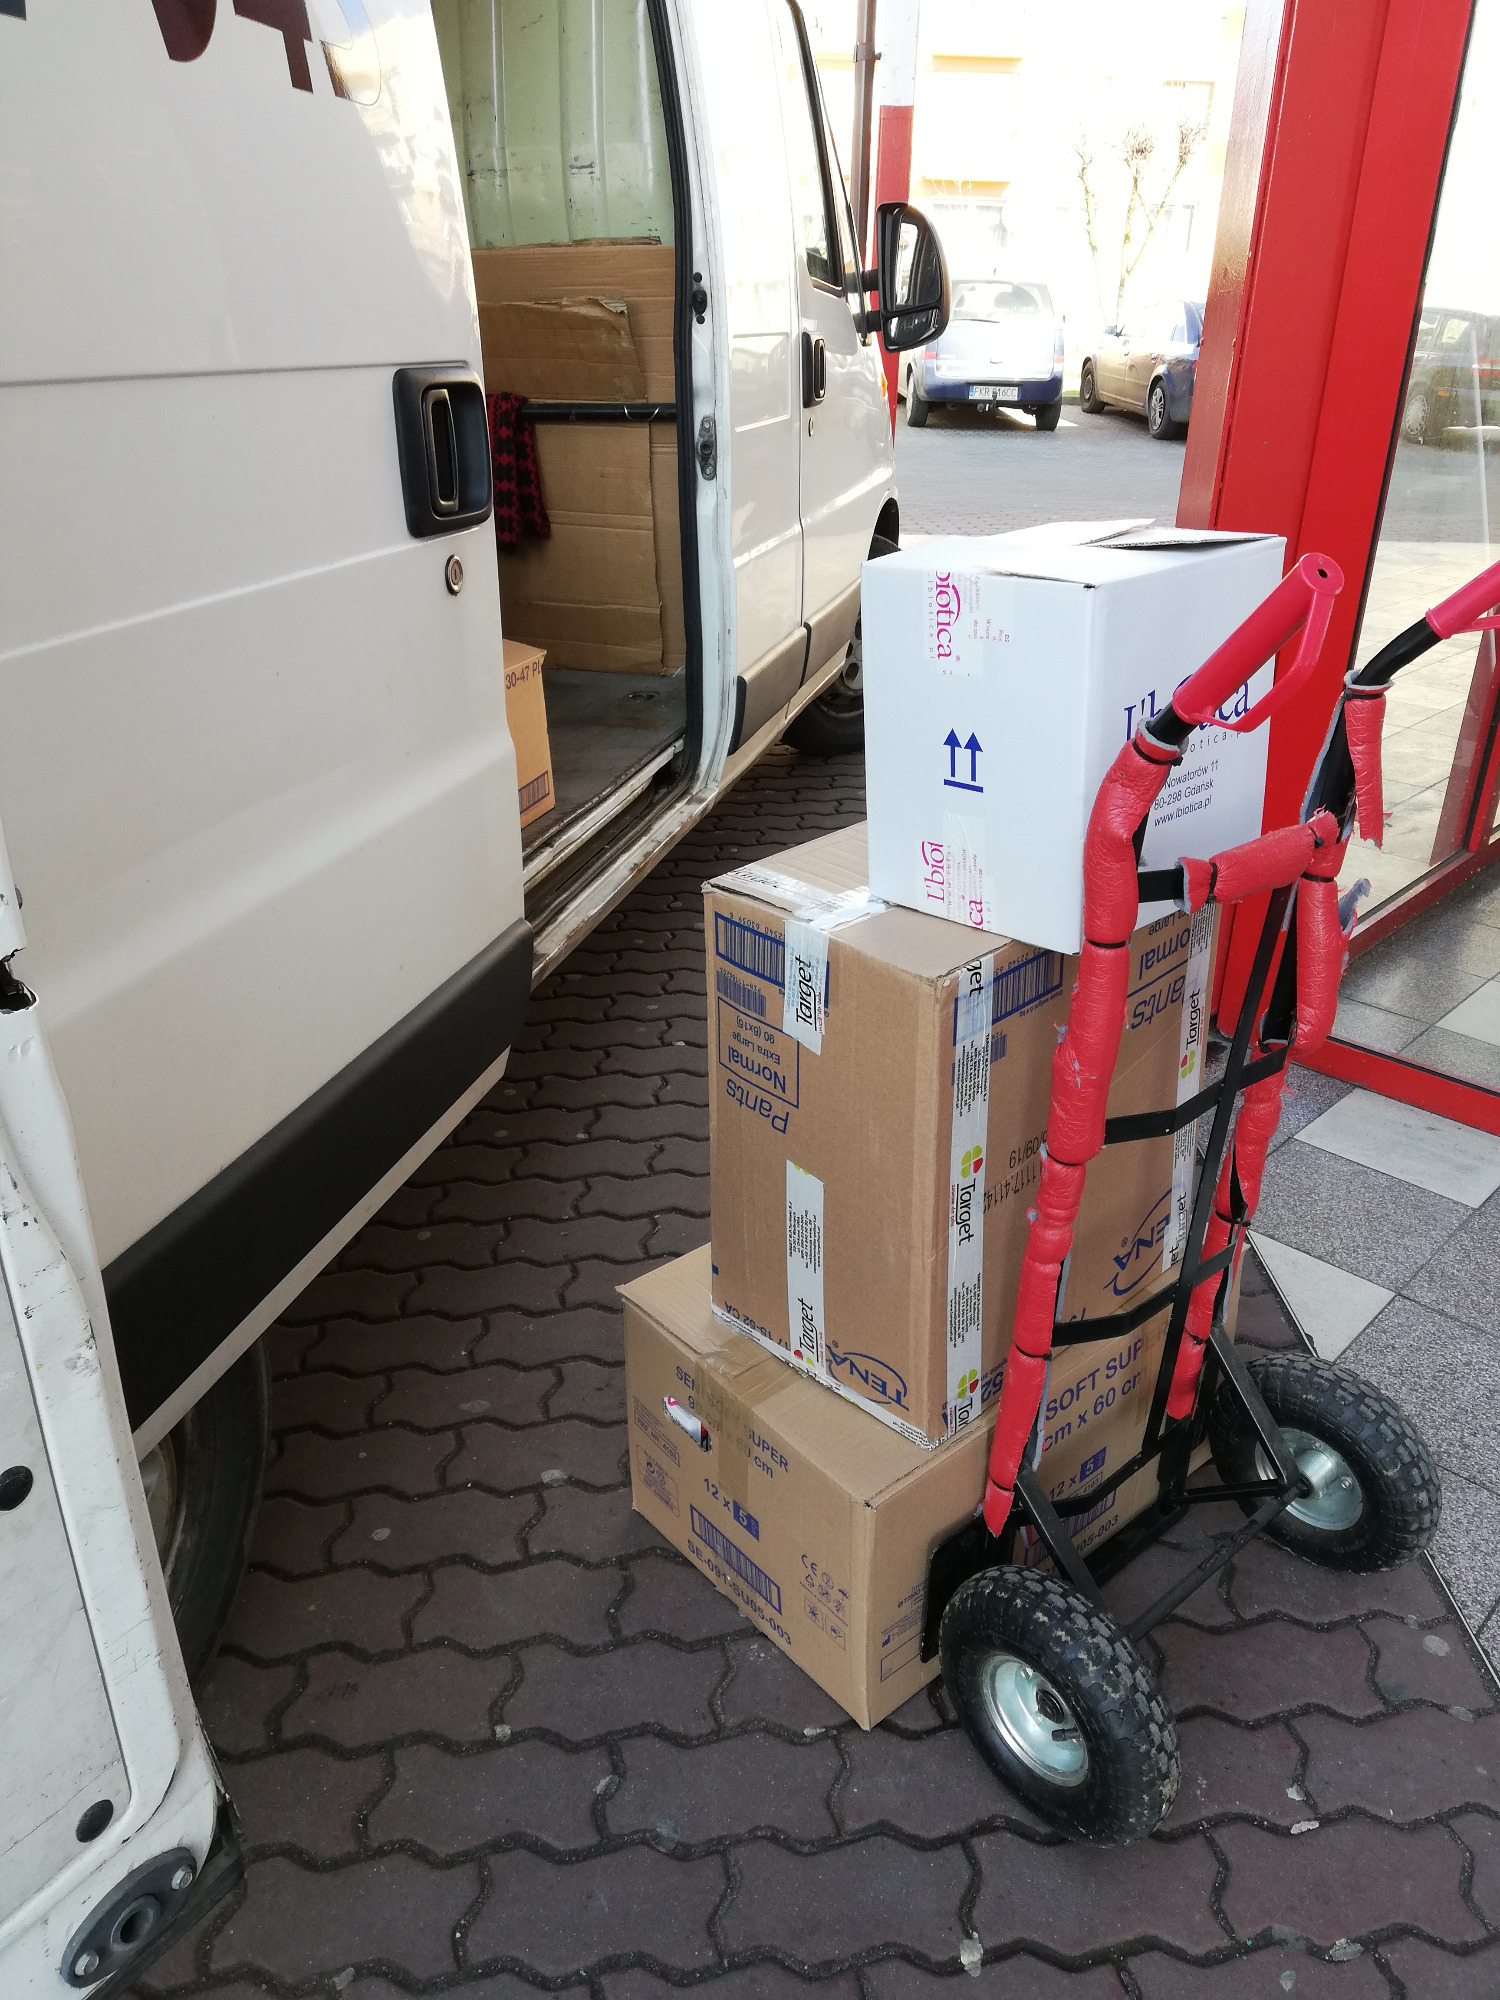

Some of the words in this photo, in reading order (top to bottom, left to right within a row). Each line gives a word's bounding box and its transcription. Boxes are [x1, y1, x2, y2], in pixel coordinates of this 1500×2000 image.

[973, 386, 990, 396] FKR
[506, 666, 530, 690] 30-47
[1210, 758, 1219, 772] 11
[1154, 789, 1182, 812] 80-298
[1184, 778, 1214, 800] Gdańsk
[1154, 794, 1212, 828] www.lbiotica.pl
[1138, 928, 1190, 980] ormal
[795, 954, 814, 1026] Target
[1131, 974, 1185, 1030] ants
[732, 1031, 755, 1051] Large
[736, 1015, 762, 1038] (6x15)
[764, 1034, 774, 1044] 90
[1186, 989, 1200, 1050] Target
[728, 1046, 786, 1094] Normal
[756, 1044, 780, 1065] Extra
[726, 1078, 790, 1134] Pants
[957, 1177, 975, 1246] Target
[1113, 1213, 1170, 1271] ENA
[724, 1301, 739, 1320] CA
[797, 1297, 815, 1355] Target
[826, 1344, 910, 1412] TENA
[1046, 1368, 1100, 1422] SOFT
[1044, 1421, 1072, 1451] cm
[1078, 1410, 1088, 1429] x
[1093, 1388, 1116, 1416] 60
[754, 1456, 773, 1478] cm
[1049, 1481, 1065, 1500] 12
[1069, 1474, 1078, 1488] x
[1086, 1459, 1094, 1476] 5
[704, 1478, 718, 1500] 12
[723, 1497, 731, 1512] x
[739, 1510, 748, 1526] 5
[1076, 1514, 1119, 1553] 05-003
[688, 1539, 792, 1646] SE-091-SU05-003
